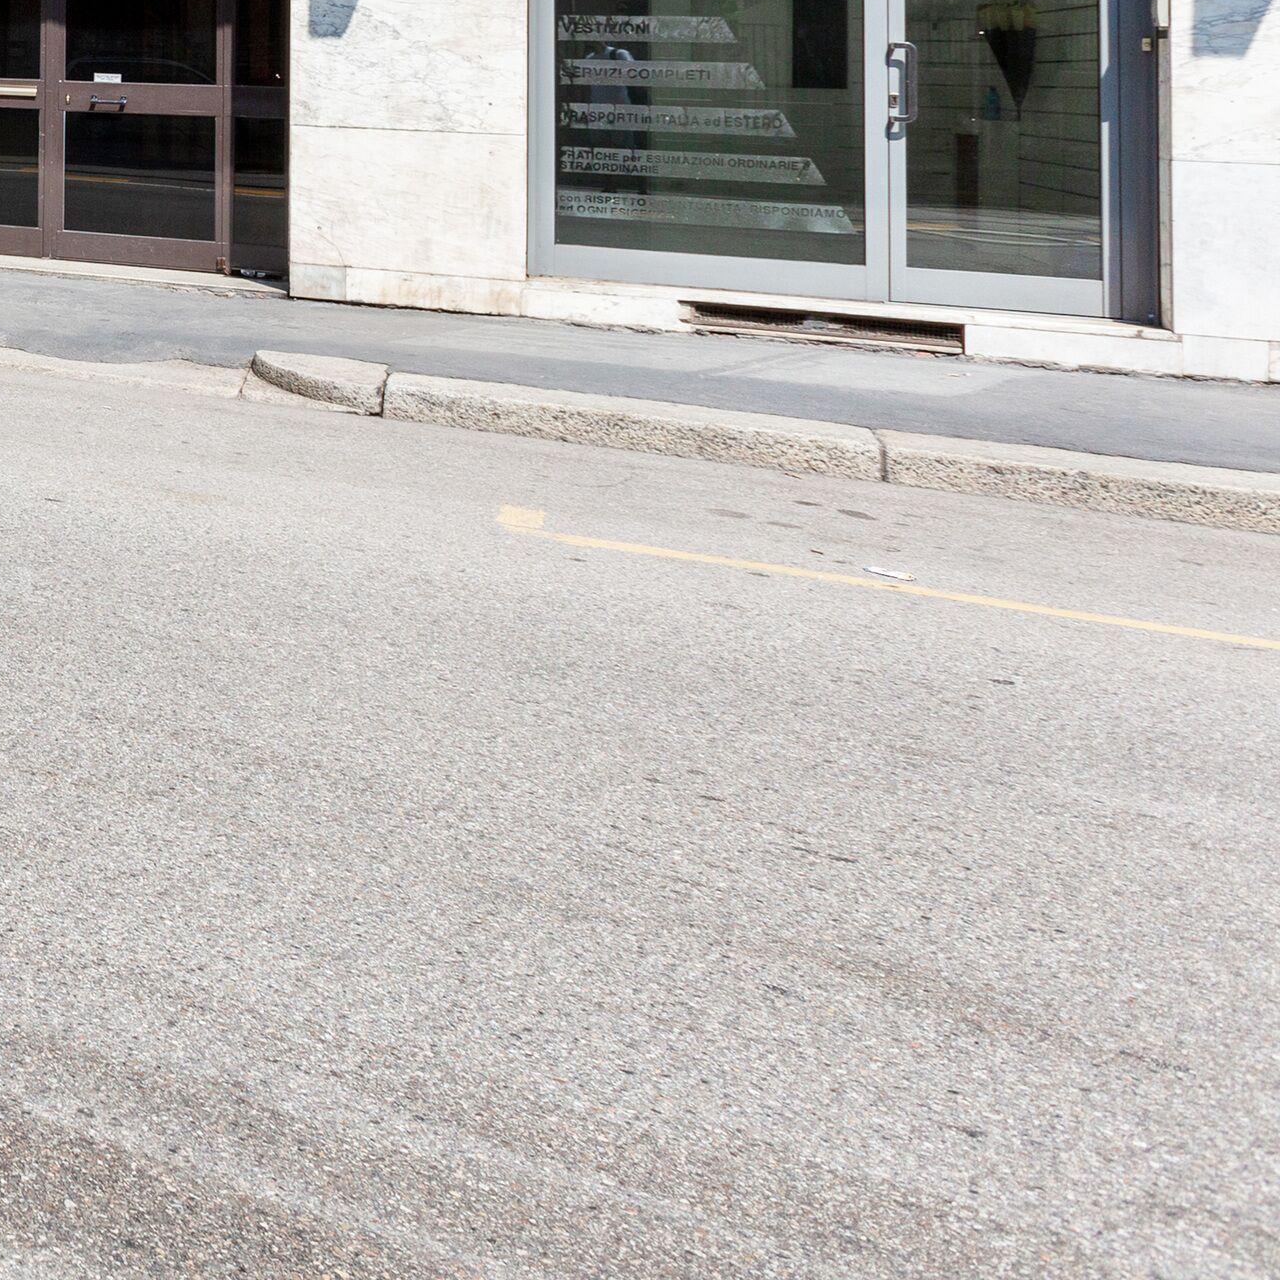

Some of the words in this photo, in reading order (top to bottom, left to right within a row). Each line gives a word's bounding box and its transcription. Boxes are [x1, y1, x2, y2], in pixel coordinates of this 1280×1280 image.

[562, 19, 650, 36] VESTIZIONI
[561, 66, 623, 78] SERVIZI
[627, 67, 711, 81] COMPLETI
[562, 110, 641, 124] TRASPORTI
[641, 113, 652, 125] in
[656, 113, 700, 127] ITALIA
[724, 114, 784, 130] ESTERO
[560, 149, 621, 162] PRATICHE
[622, 152, 641, 164] per
[646, 154, 724, 167] ESUMAZIONI
[727, 157, 799, 171] ORDINARIE
[560, 160, 659, 175] STRAORDINARIE
[584, 194, 647, 207] RISPETTO
[748, 204, 847, 219] RISPONDIAMO
